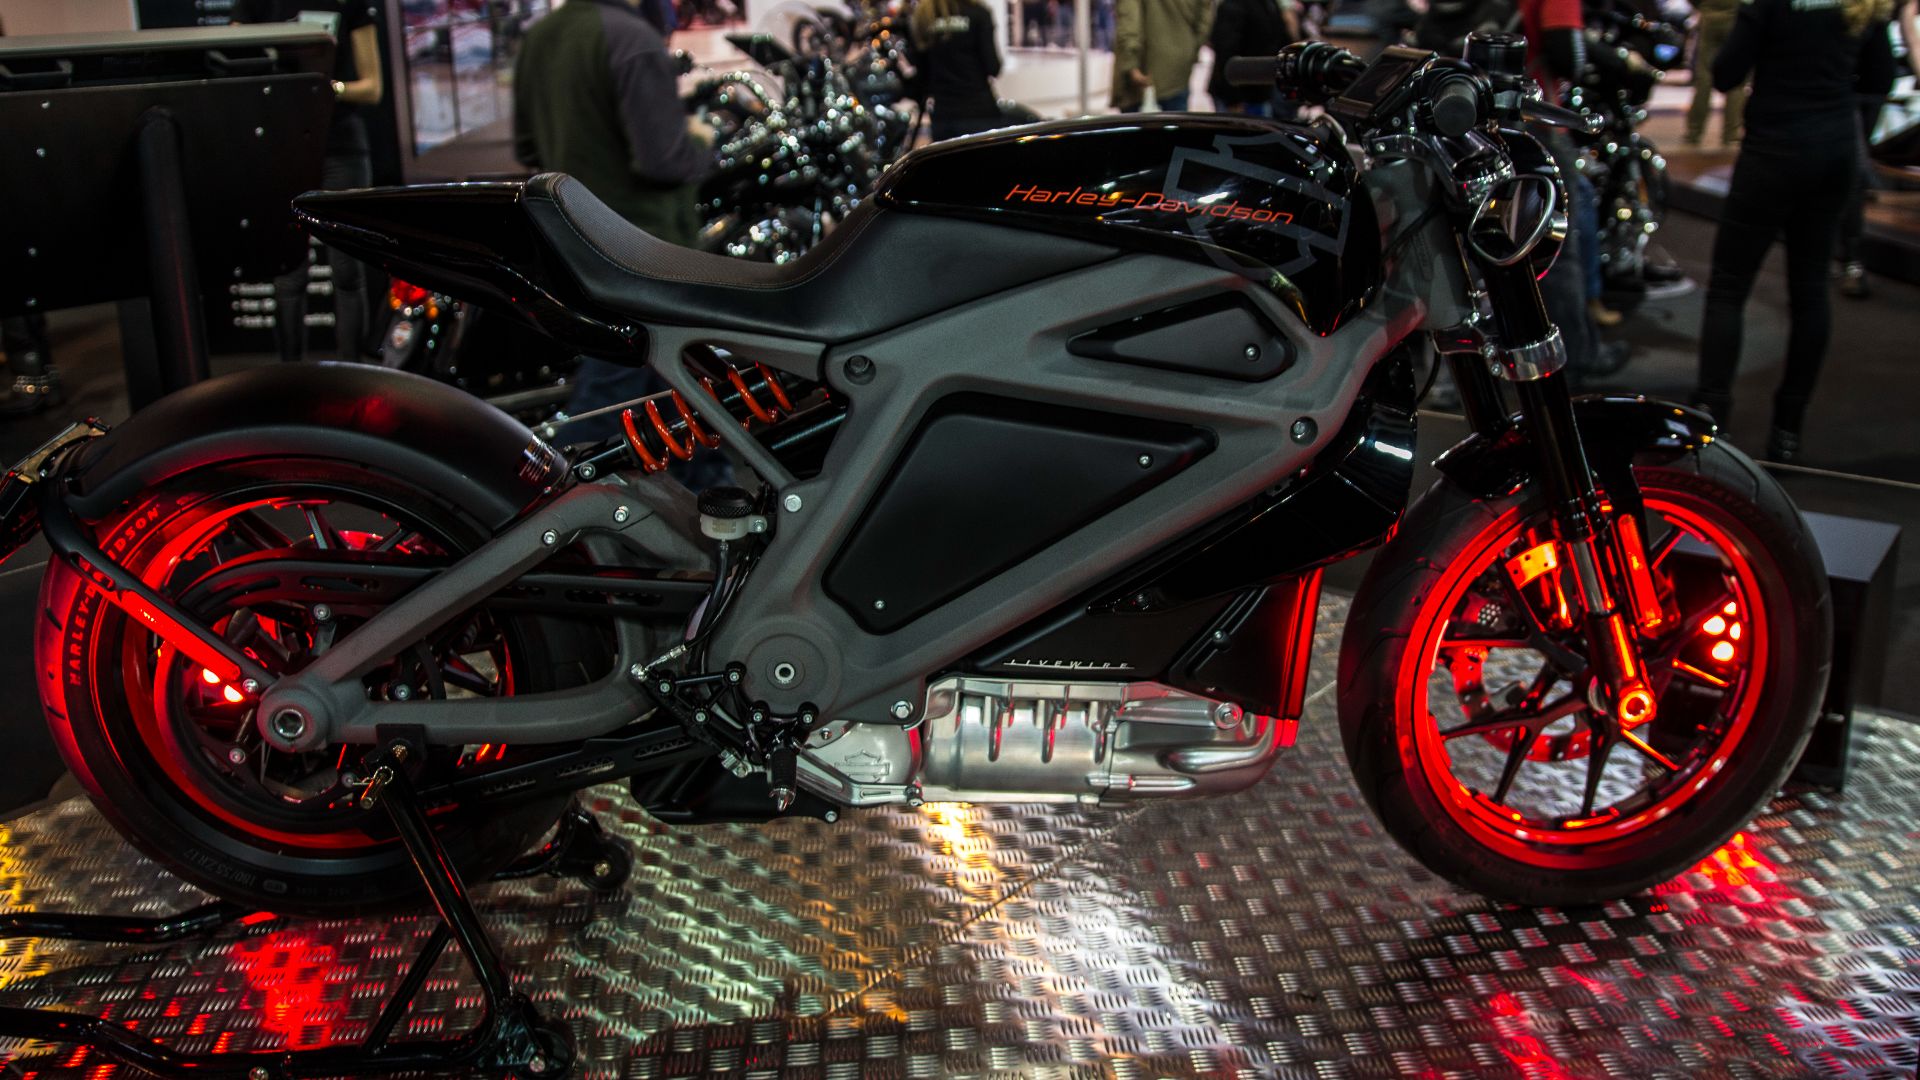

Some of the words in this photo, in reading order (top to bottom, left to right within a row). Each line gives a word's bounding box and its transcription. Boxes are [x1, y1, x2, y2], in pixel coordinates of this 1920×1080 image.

[1004, 184, 1294, 225] Harley-Davidson
[69, 504, 159, 686] HARLEY-DIDSON
[1010, 658, 1128, 669] LIVEWIRE
